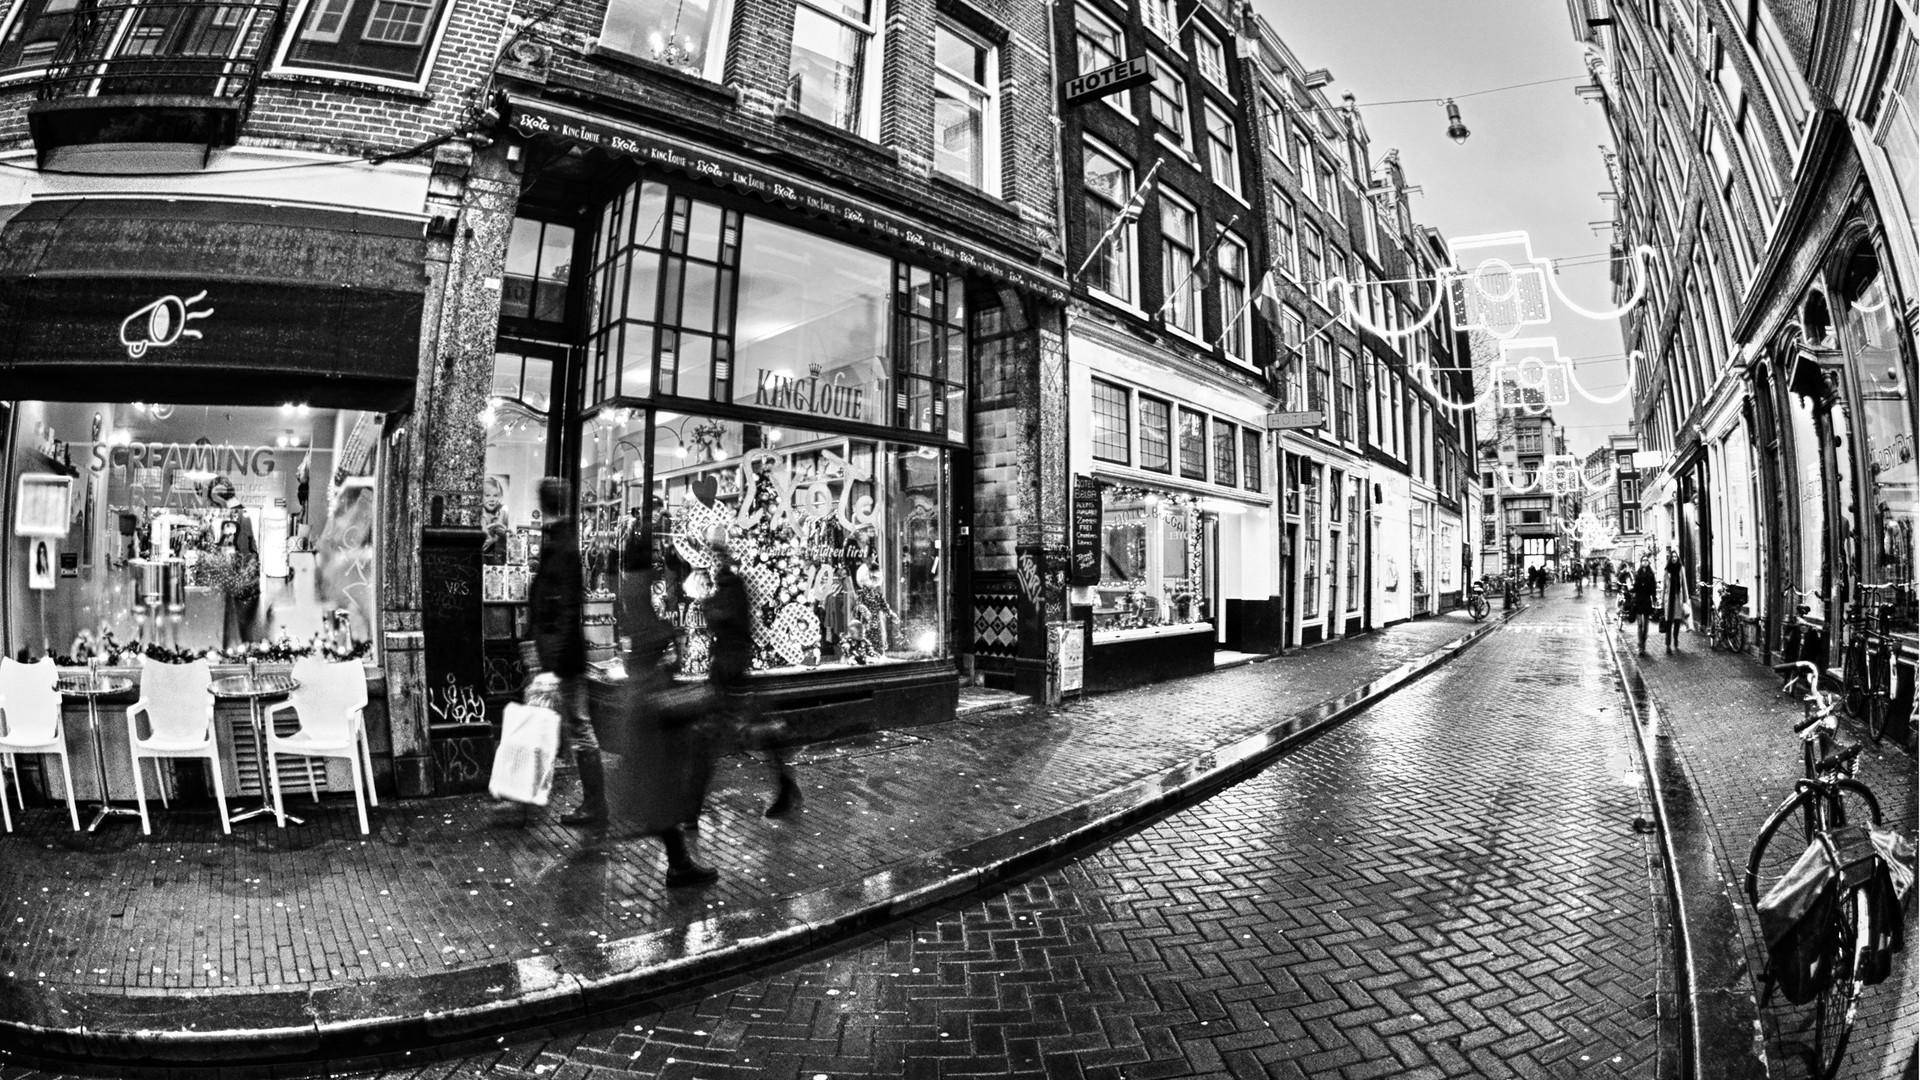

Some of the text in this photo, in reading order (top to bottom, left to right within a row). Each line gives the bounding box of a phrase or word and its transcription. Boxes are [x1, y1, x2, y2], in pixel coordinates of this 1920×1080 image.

[1070, 61, 1142, 96] HOTEL
[755, 368, 863, 419] KING LOUIE
[1271, 413, 1318, 426] HOTEL
[90, 443, 275, 477] SCREAMING
[846, 544, 869, 559] first
